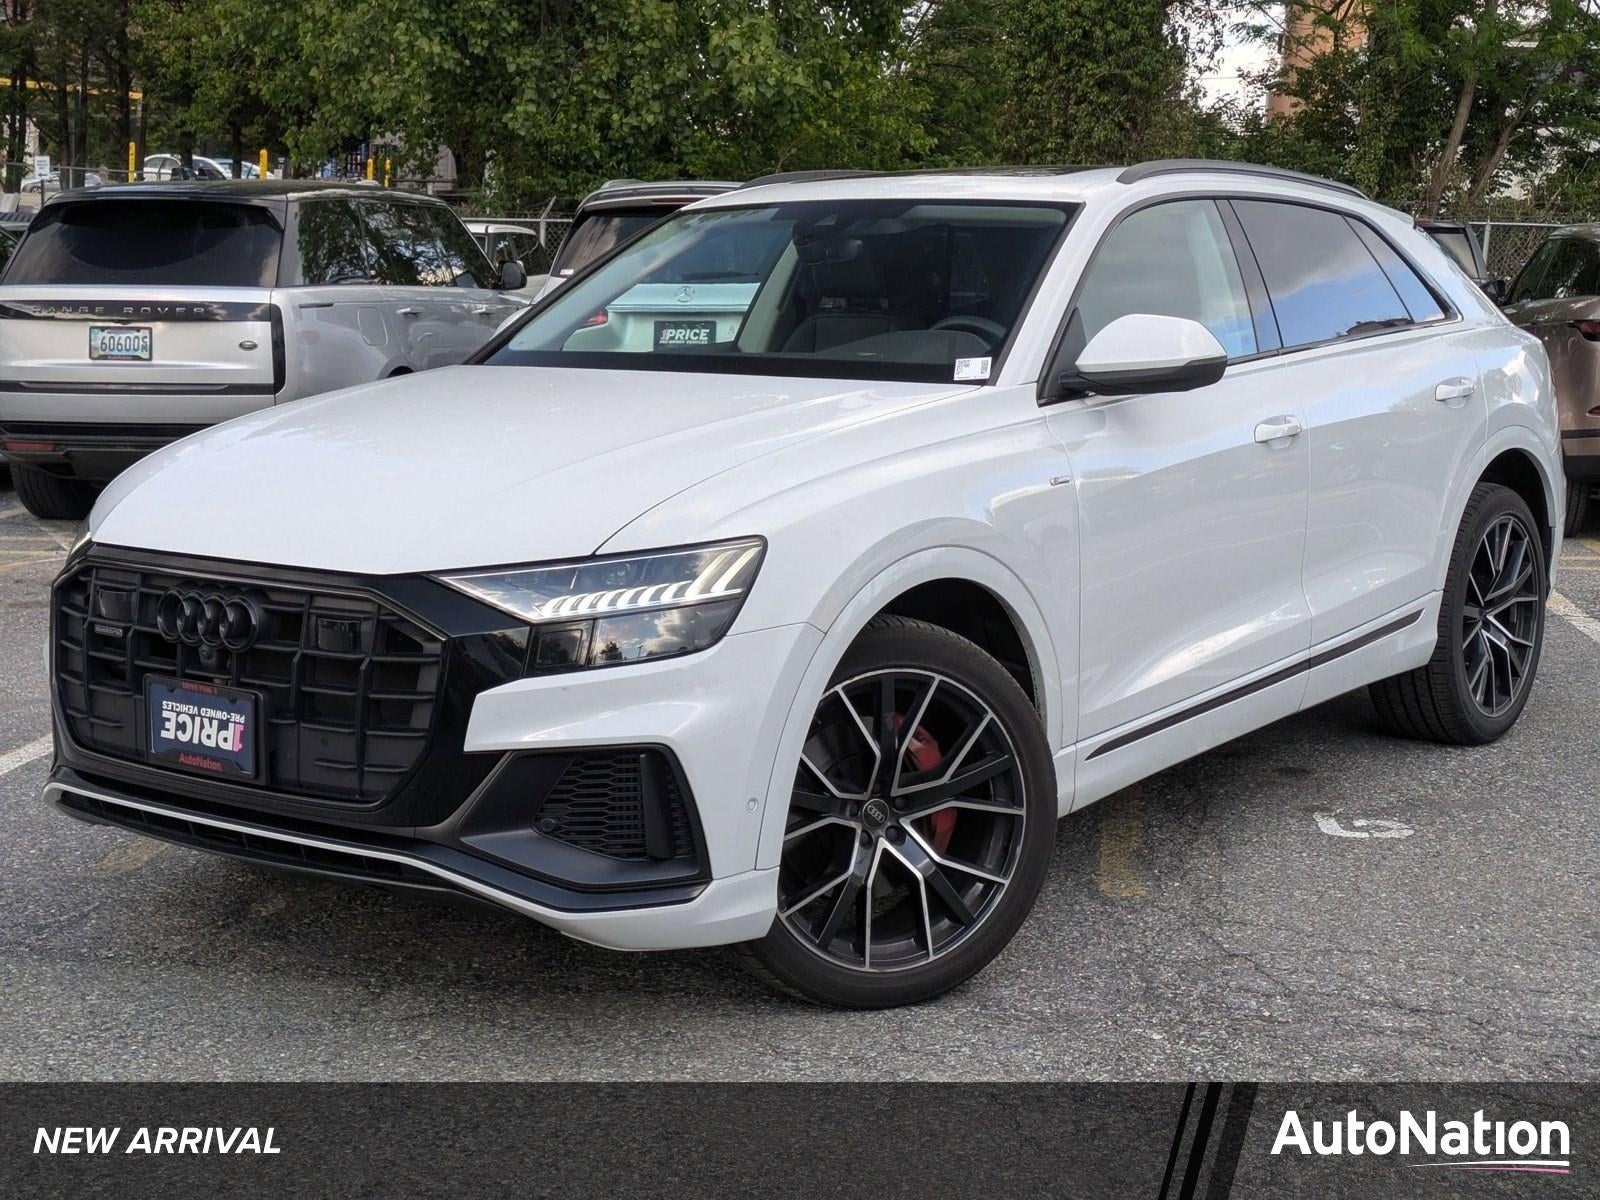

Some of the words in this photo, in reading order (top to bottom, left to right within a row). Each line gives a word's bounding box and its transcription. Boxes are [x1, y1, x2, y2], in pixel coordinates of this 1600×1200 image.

[32, 305, 105, 314] RANGE
[123, 306, 205, 314] ROVER
[162, 700, 199, 714] VEHICLES
